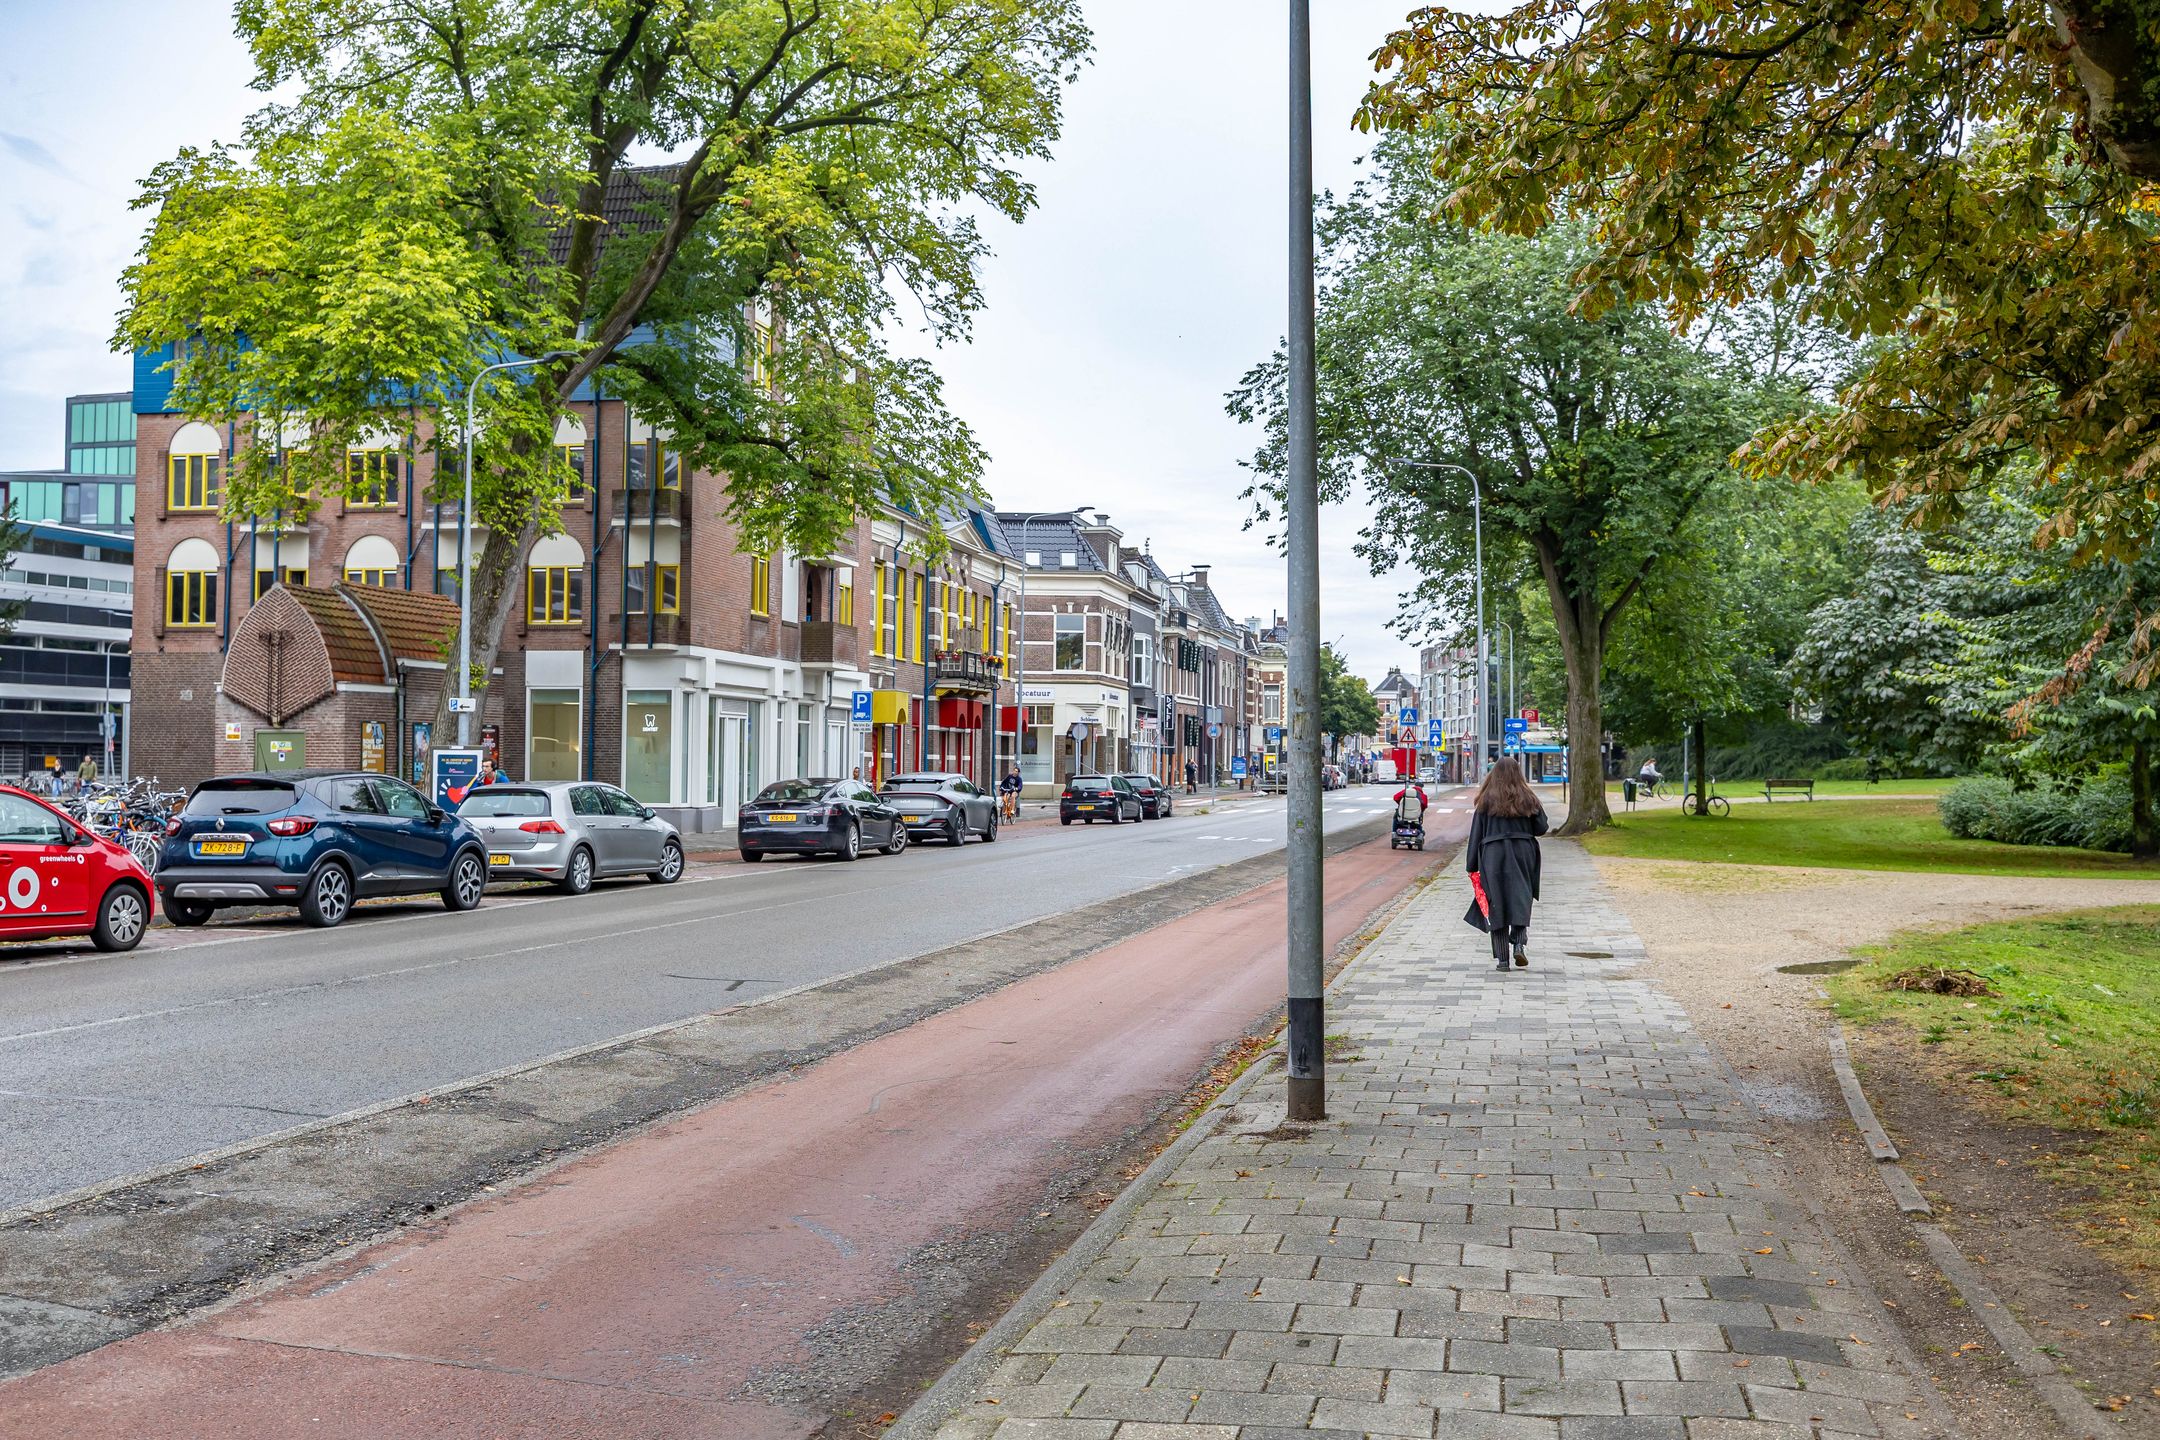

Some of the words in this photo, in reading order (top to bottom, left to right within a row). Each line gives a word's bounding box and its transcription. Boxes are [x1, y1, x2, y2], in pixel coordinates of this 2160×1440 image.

[857, 694, 868, 710] P
[204, 843, 242, 852] ZK-728-F
[40, 855, 76, 864] greenwheels
